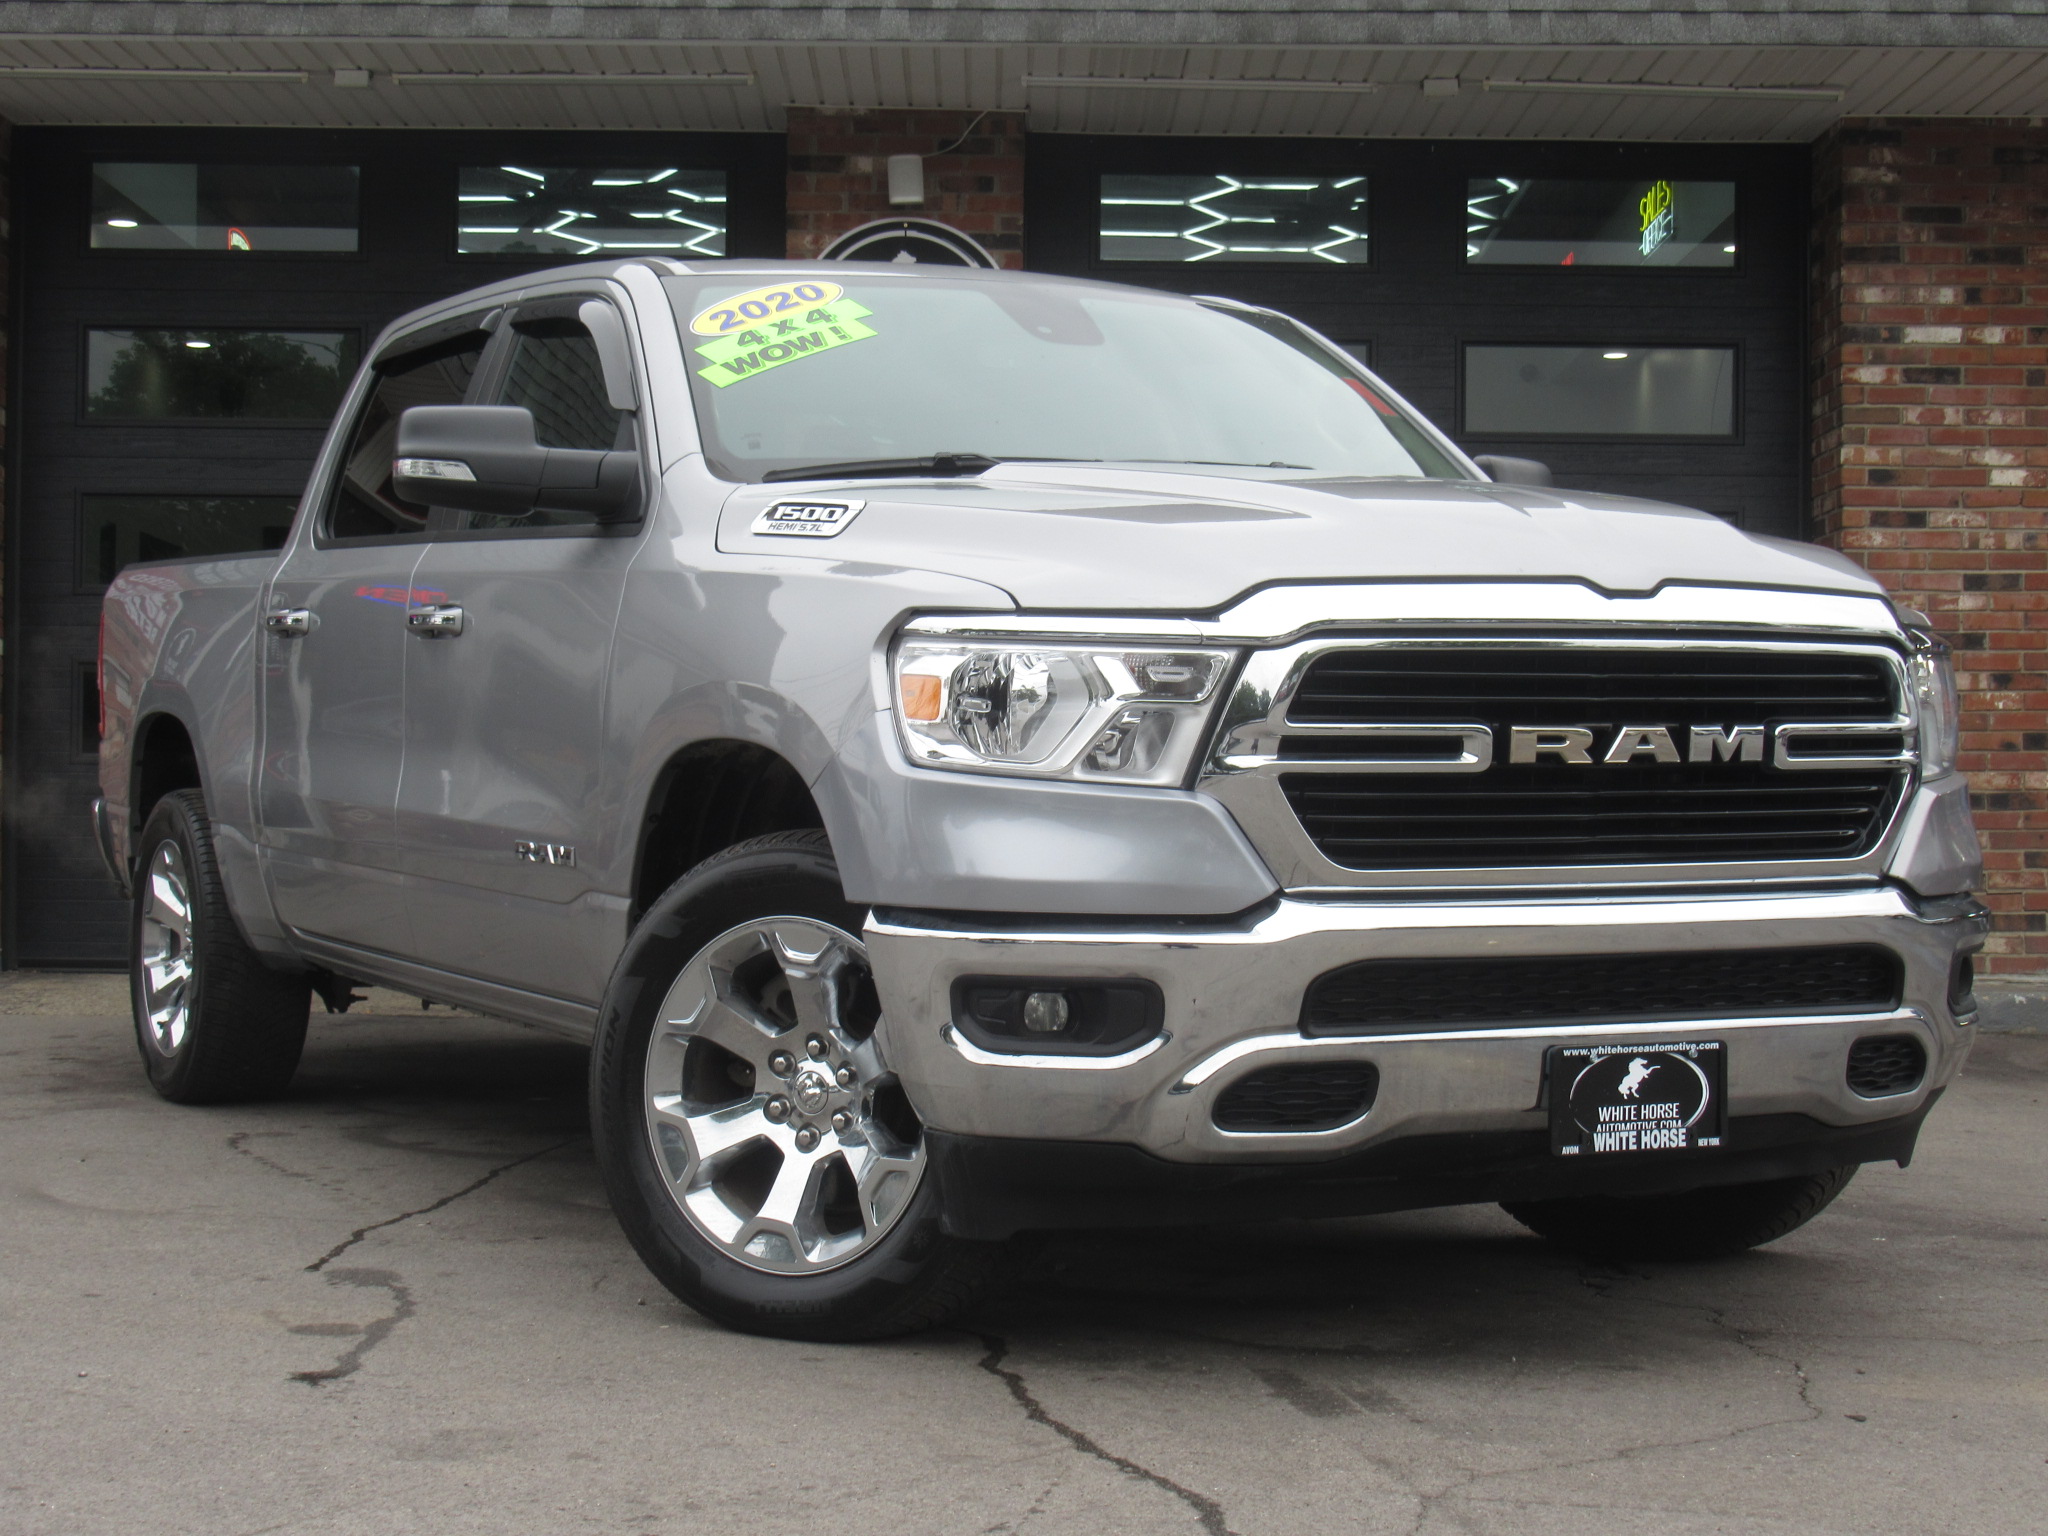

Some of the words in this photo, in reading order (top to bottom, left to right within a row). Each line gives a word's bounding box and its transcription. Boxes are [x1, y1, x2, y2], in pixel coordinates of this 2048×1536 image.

[1639, 181, 1670, 232] SALES
[709, 284, 826, 332] 2020
[774, 506, 844, 520] 1500
[768, 522, 798, 531] HEMI
[798, 523, 823, 532] 5.7L
[1509, 725, 1765, 764] RAM
[515, 840, 576, 867] RAM
[1563, 1042, 1719, 1056] www.whitehorseautomotive.com
[1598, 1105, 1637, 1122] WHITE
[1641, 1102, 1680, 1119] HORSE
[1596, 1119, 1682, 1132] AUTOMOTIVECOM
[1593, 1130, 1637, 1152] WHITE
[1641, 1128, 1687, 1149] HORSE
[1698, 1138, 1708, 1146] NEW
[1562, 1146, 1579, 1155] AVON
